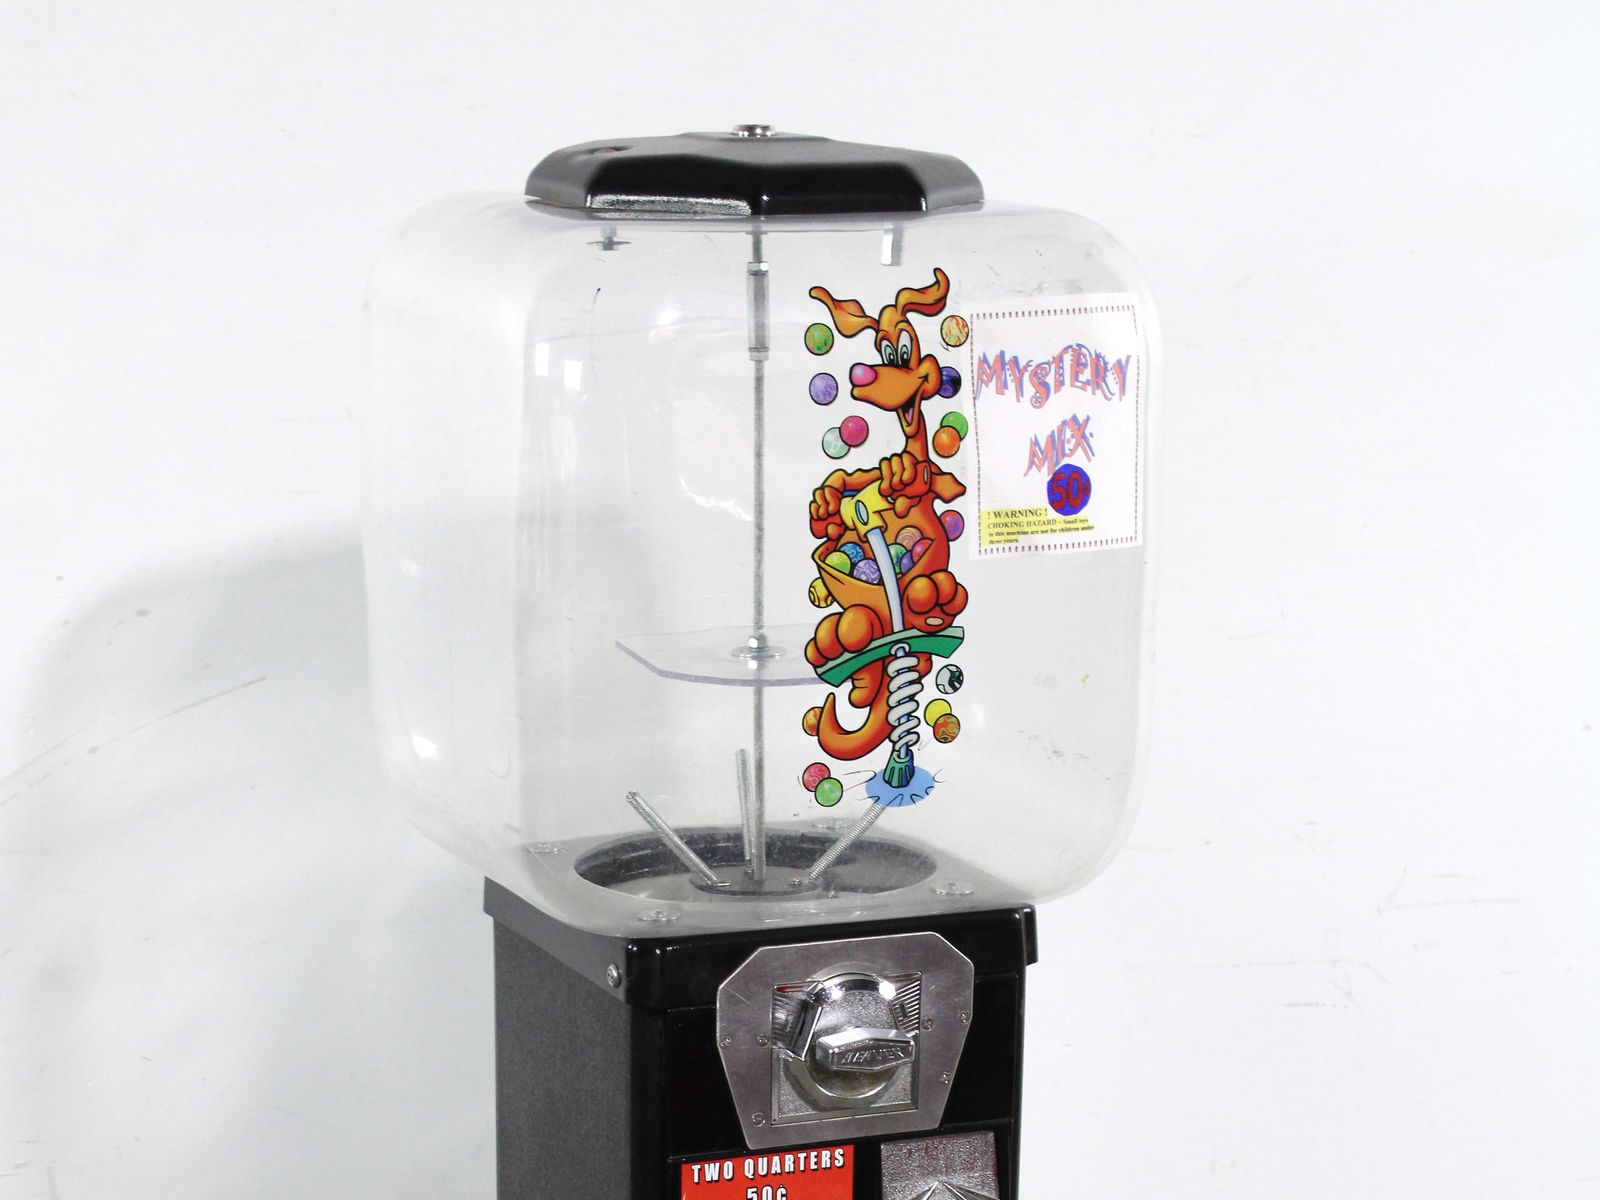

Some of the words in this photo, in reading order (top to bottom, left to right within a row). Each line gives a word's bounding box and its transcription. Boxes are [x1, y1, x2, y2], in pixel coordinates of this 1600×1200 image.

[975, 343, 1132, 409] MYSTERY
[1024, 413, 1095, 477] MIX
[988, 521, 1024, 530] CHOKING
[1026, 518, 1057, 528] HAZARD
[1063, 517, 1078, 525] Small
[993, 508, 1042, 519] WARNING
[1080, 524, 1095, 532] under
[691, 1160, 735, 1184] TWO
[743, 1148, 846, 1179] QUARTERS
